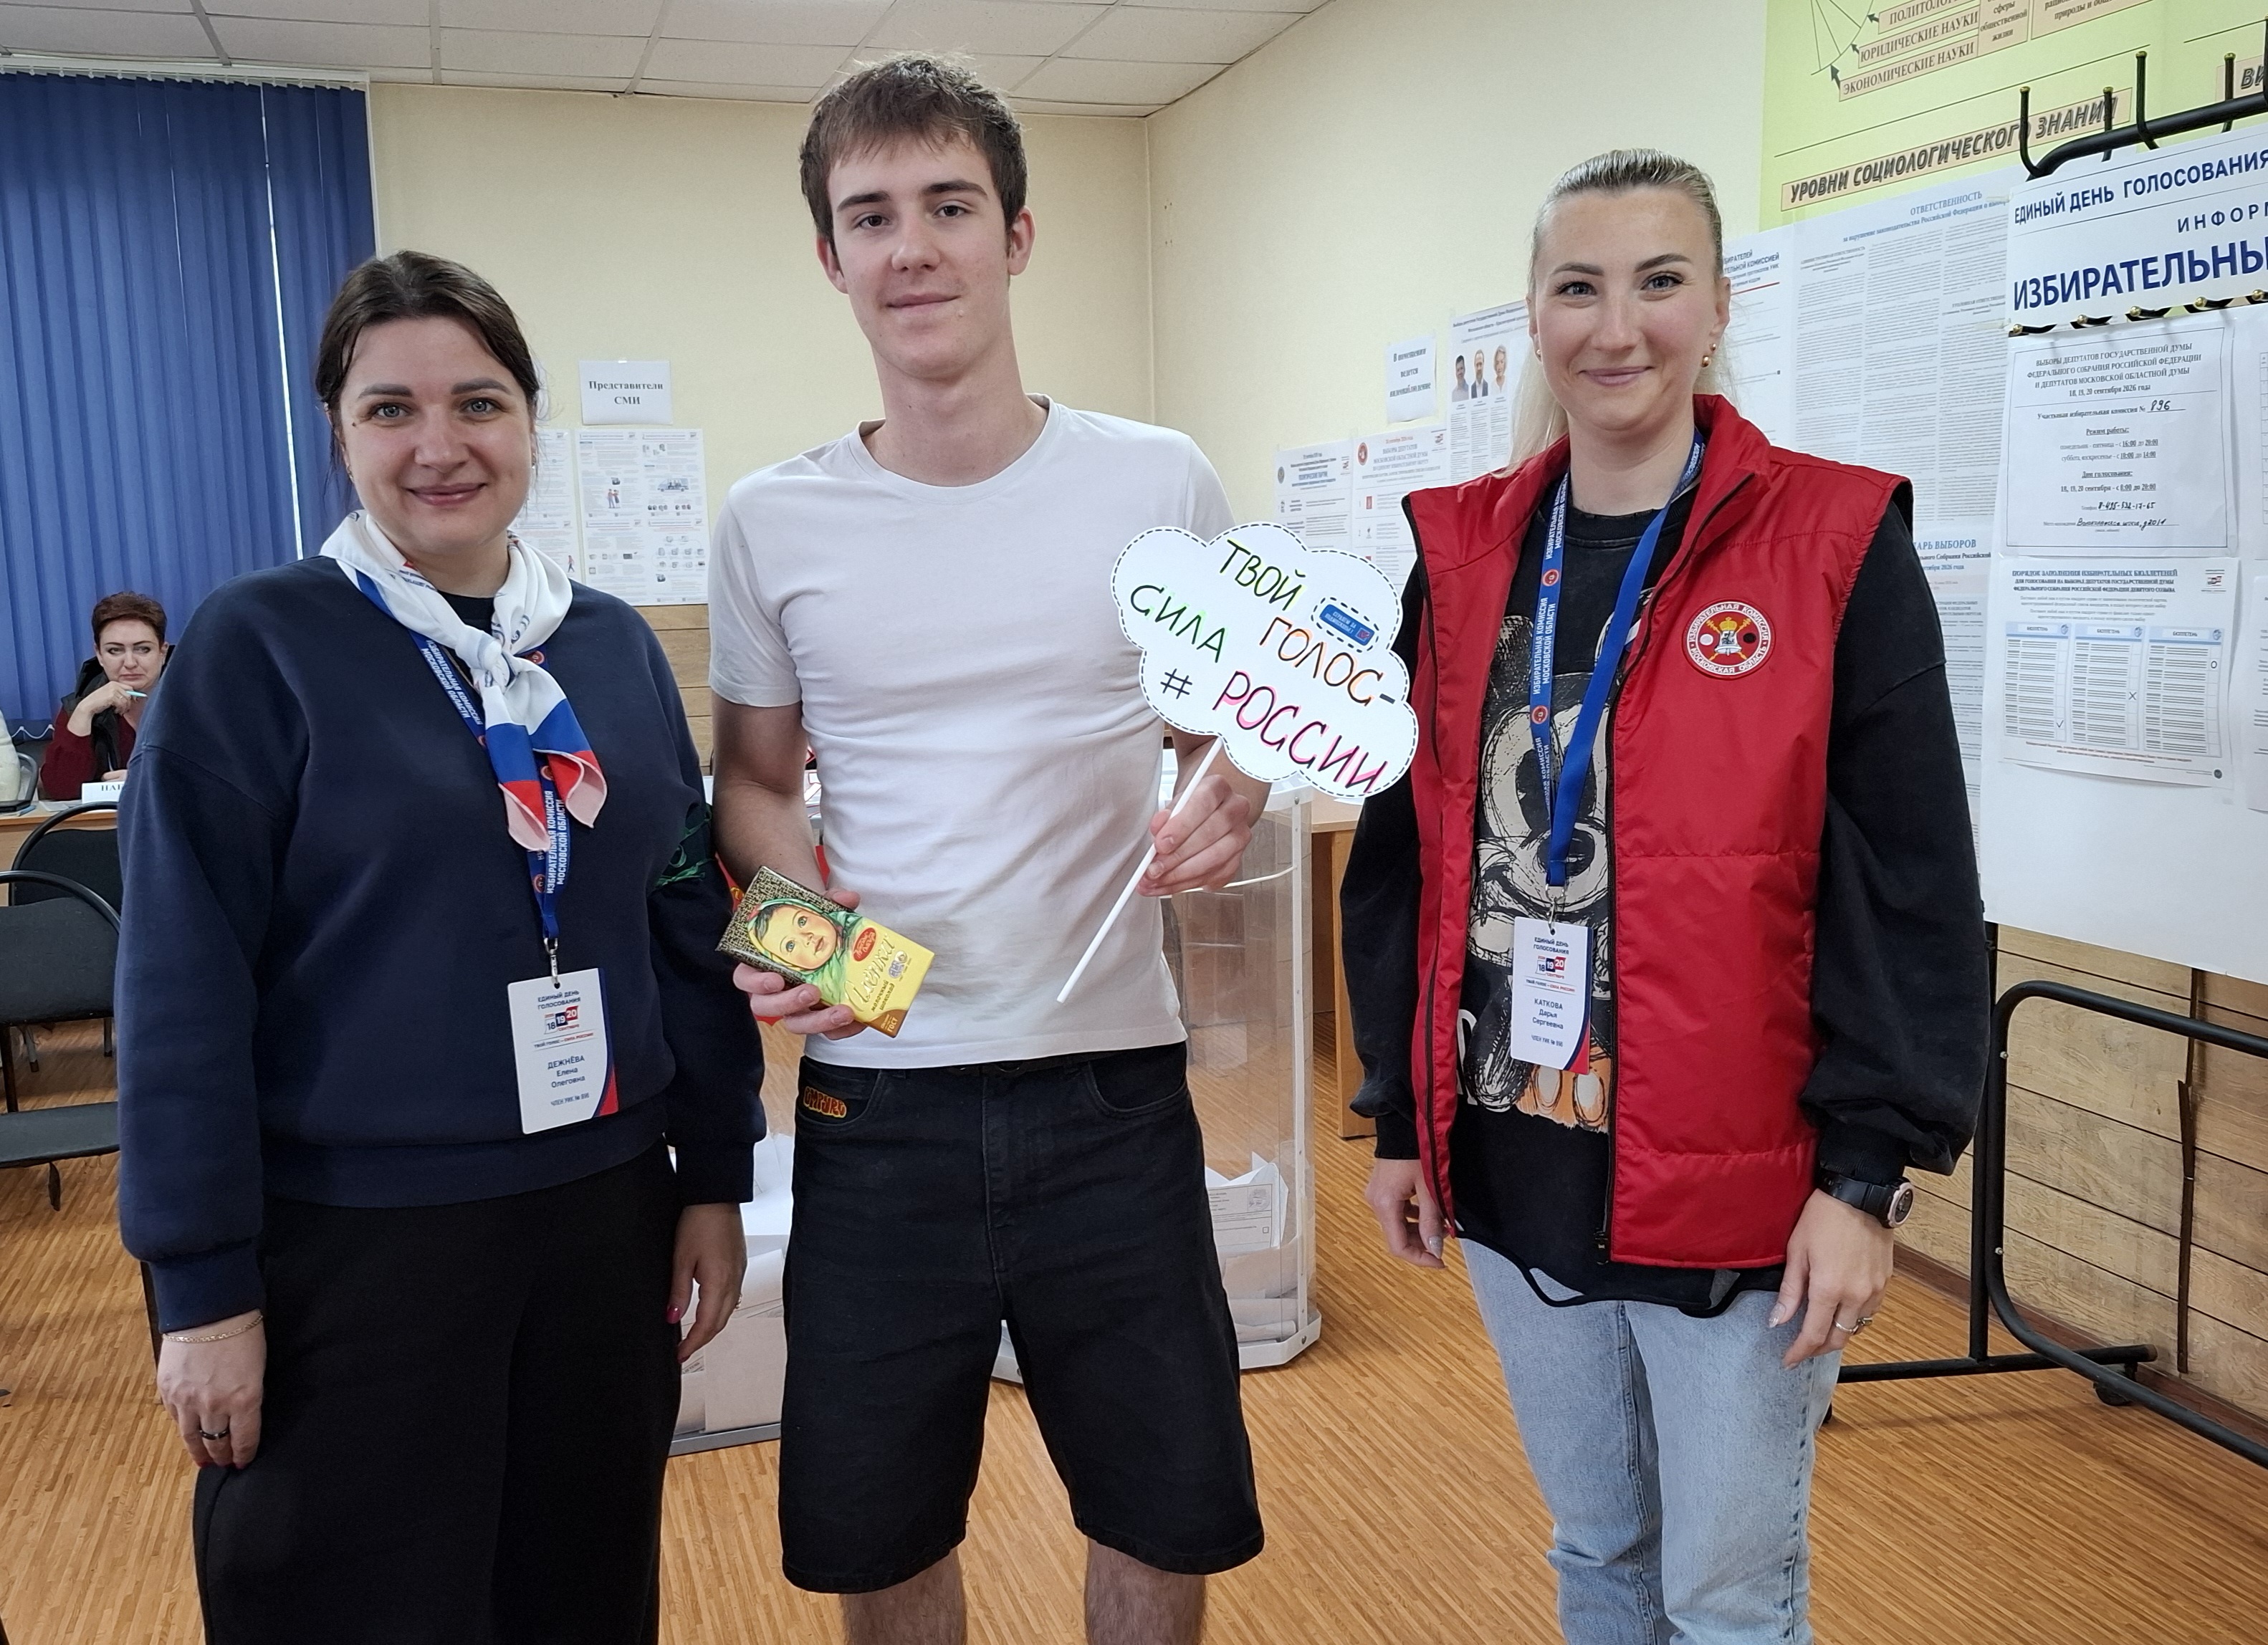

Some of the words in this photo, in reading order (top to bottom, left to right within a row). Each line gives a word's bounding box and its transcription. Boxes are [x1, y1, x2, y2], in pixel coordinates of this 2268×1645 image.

[1980, 9, 2027, 32] общественной
[1860, 25, 1939, 62] ЮРИДИЧЕСКИЕ
[1941, 11, 1979, 35] НАУКИ
[1842, 55, 1935, 95] ЭКОНОМИЧЕСКИЕ
[1937, 42, 1975, 65] НАУКИ
[1790, 170, 1848, 203] УРОВНИ
[2014, 191, 2066, 225] ЕДИНЫЙ
[2070, 185, 2114, 214] ДЕНЬ
[2123, 149, 2268, 198] ГОЛОСОВАНИЯ
[1910, 191, 1983, 216] ОТВЕТСТВЕННОСТЬ
[2177, 202, 2268, 234] ИНФОР
[2027, 366, 2075, 378] ФЕДЕРАЛЬНОГО
[2076, 363, 2110, 373] СОБРАНИЯ
[2111, 356, 2157, 370] РОССИЙСКОЙ
[2158, 353, 2201, 365] ФЕДЕРАЦИИ
[2062, 353, 2099, 365] ДЕПУТАТОВ
[2100, 344, 2168, 360] ГОСУДАРСТВЕННОЙ
[2169, 342, 2193, 353] ДУМЫ
[588, 380, 664, 391] Представители
[2040, 378, 2077, 389] ДЕПУТАТОВ
[2078, 373, 2123, 385] МОСКОВСКОЙ
[2124, 368, 2167, 380] ОБЛАСТНОЙ
[2168, 367, 2190, 377] ДУМЫ
[2122, 384, 2137, 393] 2026
[614, 395, 641, 405] СМИ
[1914, 541, 1933, 550] АРЬ
[1934, 539, 1977, 550] ВЫБОРОВ
[1220, 539, 1306, 611] ТВОЙ
[1130, 585, 1226, 663] СИЛА
[1536, 597, 1549, 635] КОМИССИЯ
[1545, 603, 1556, 635] ОБЛАСТИ
[1688, 603, 1739, 643] ИЗБИРАТЕЛЬНАЯ
[1741, 606, 1769, 641] КОМИССИЯ
[1533, 636, 1543, 695] ИЗБИРАТЕЛЬНАЯ
[1542, 635, 1552, 685] МОСКОВСКОЙ
[1690, 647, 1736, 673] МОСКОВСКАЯ
[1738, 646, 1768, 671] ОБЛАСТЬ
[421, 648, 453, 690] МОСКОВСКОЙ
[448, 690, 472, 719] ОБЛАСТИ
[426, 640, 462, 691] ИЗБИРАТЕЛЬНАЯ
[456, 691, 484, 725] КОМИССИЯ
[1212, 671, 1389, 794] РОССИИ
[545, 790, 556, 829] КОМИССИЯ
[556, 799, 568, 831] ОБЛАСТИ
[546, 831, 557, 894] ИЗБИРАТЕЛЬНАЯ
[557, 832, 568, 885] МОСКОВСКОЙ
[1533, 944, 1569, 955] ГОЛОСОВАНИЯ
[1534, 936, 1555, 945] ЕДИНЫЙ
[1538, 964, 1546, 972] 18
[1546, 961, 1554, 969] 19
[1554, 959, 1564, 968] 20
[537, 992, 563, 1002] ЕДИНЫЙ
[537, 997, 581, 1009] ГОЛОСОВАНИЯ
[1534, 997, 1564, 1010] КАТКОВА
[547, 1022, 556, 1030] 18
[556, 1015, 566, 1025] 19
[566, 1009, 577, 1019] 20
[1532, 1016, 1564, 1030] Сергеевна
[1539, 1008, 1558, 1019] Дарья
[547, 1055, 585, 1070] ДЕЖНЁВА
[556, 1067, 578, 1077] Елена
[551, 1075, 585, 1088] Олеговна
